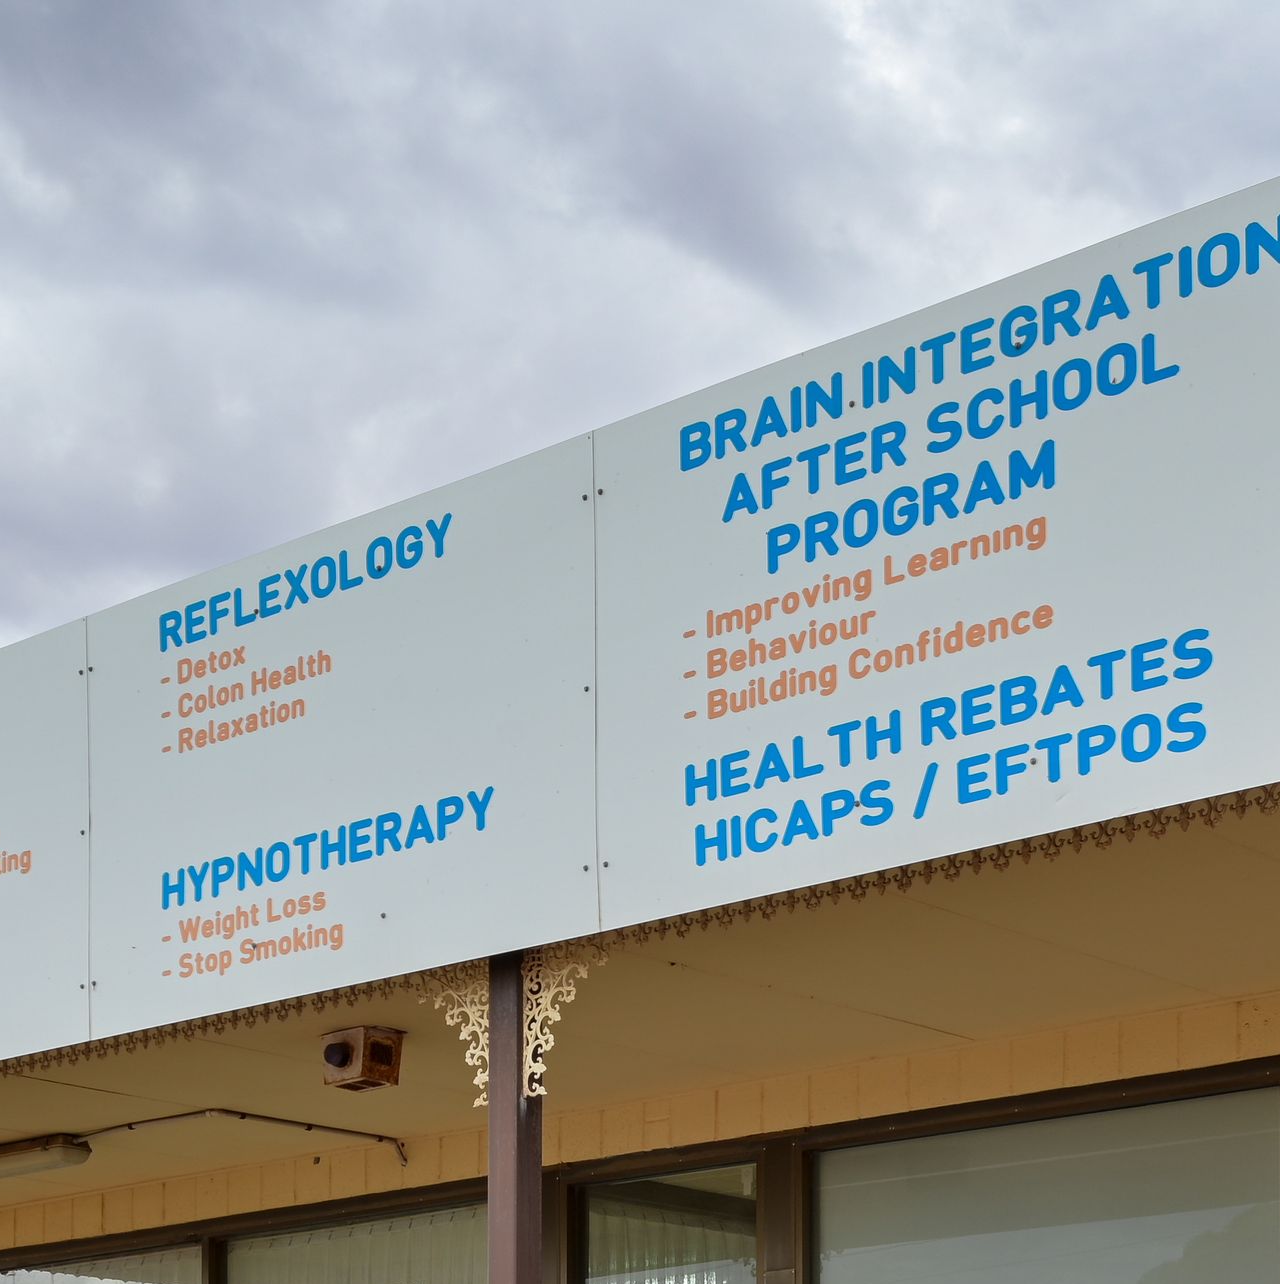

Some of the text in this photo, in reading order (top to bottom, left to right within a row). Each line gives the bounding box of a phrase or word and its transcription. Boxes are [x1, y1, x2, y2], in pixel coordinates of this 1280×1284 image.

[678, 372, 843, 473] BRAIN
[720, 333, 1180, 524] AFTER SCHOOL
[766, 439, 1055, 576] PROGRAM
[158, 512, 452, 654] REFLEXOLOGY
[705, 568, 872, 640] Improving
[882, 515, 1047, 586] Learning
[176, 645, 246, 685] Detox
[177, 682, 244, 719] Colon
[250, 650, 332, 696] Health
[705, 610, 876, 680] Behaviour
[705, 663, 837, 720] Building
[847, 603, 1054, 681] Confidence
[177, 698, 306, 752] Relaxation
[683, 628, 1214, 808] HEALTH REBATES
[693, 779, 893, 868] HICAPS
[954, 702, 1207, 805] EFTPOS
[160, 786, 494, 911] HYPNOTHERAPY
[177, 950, 233, 979] Stop
[238, 923, 344, 965] Smoking
[178, 903, 260, 944] Weight
[265, 890, 328, 923] Loss
